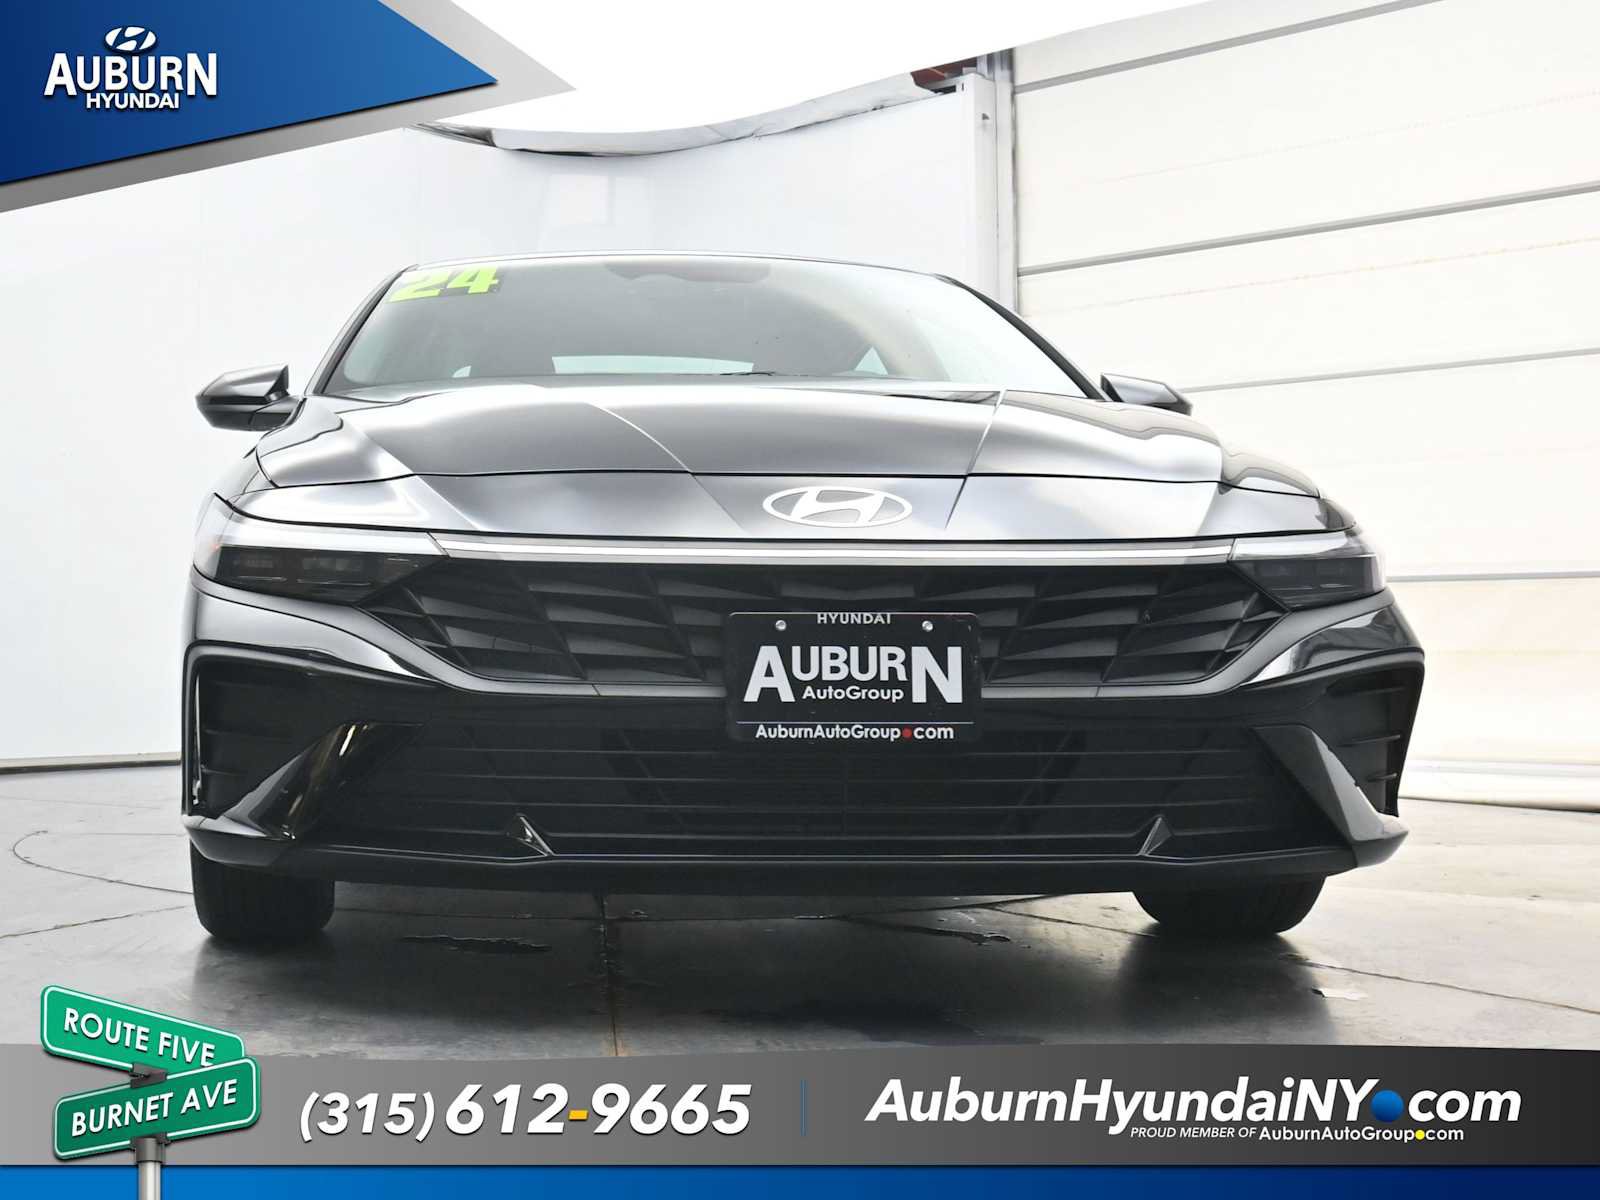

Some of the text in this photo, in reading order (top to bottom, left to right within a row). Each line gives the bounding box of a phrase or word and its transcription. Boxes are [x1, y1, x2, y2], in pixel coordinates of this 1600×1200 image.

[388, 266, 499, 303] 24
[816, 612, 892, 625] HYUNDAI
[743, 645, 963, 704] AUBURN
[802, 685, 904, 703] AutoGroup
